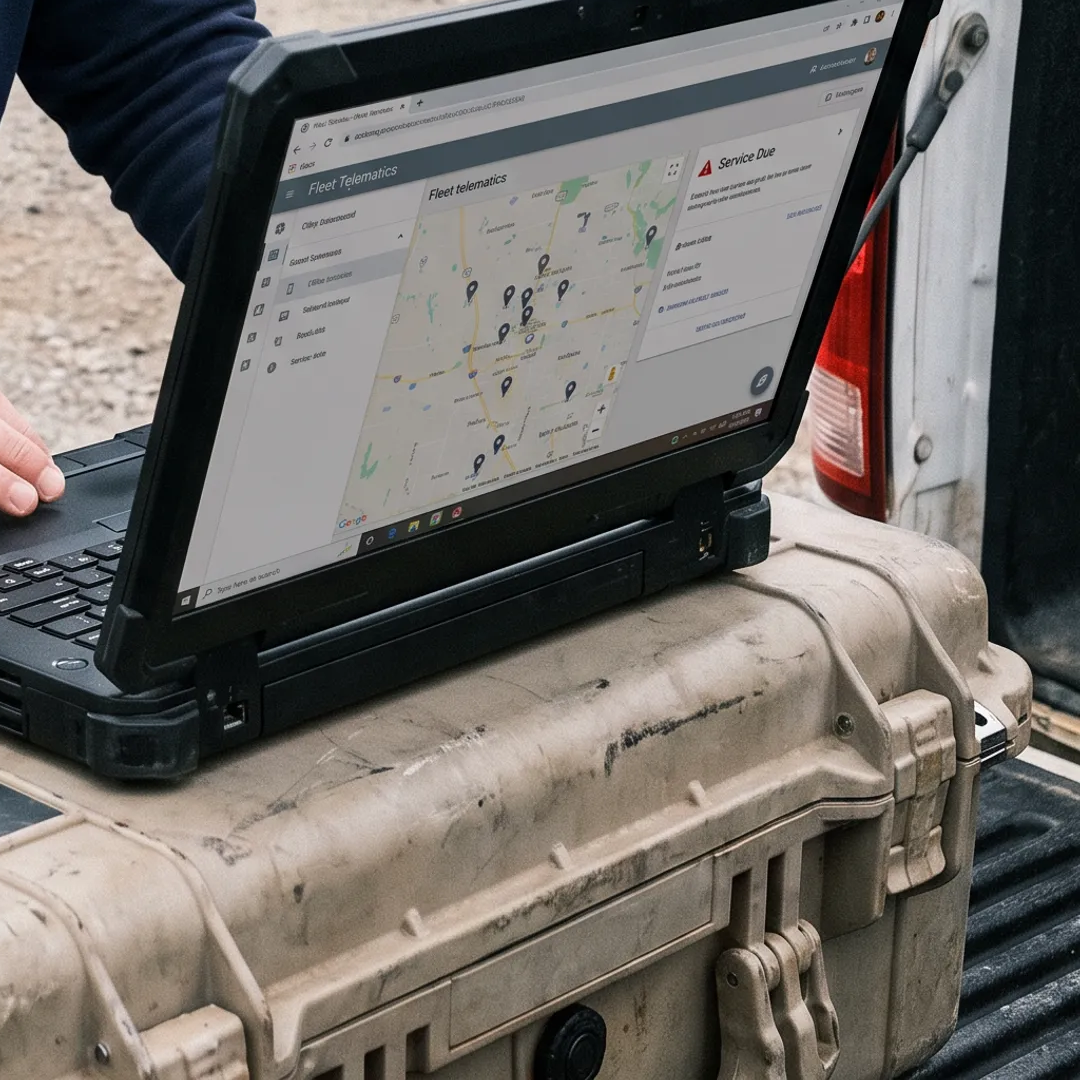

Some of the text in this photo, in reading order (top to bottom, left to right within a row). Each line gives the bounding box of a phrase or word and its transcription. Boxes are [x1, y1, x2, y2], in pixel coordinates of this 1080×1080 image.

[718, 147, 776, 169] Service Due
[308, 165, 398, 196] Fleet Telematics
[428, 173, 508, 201] Fleet telematics
